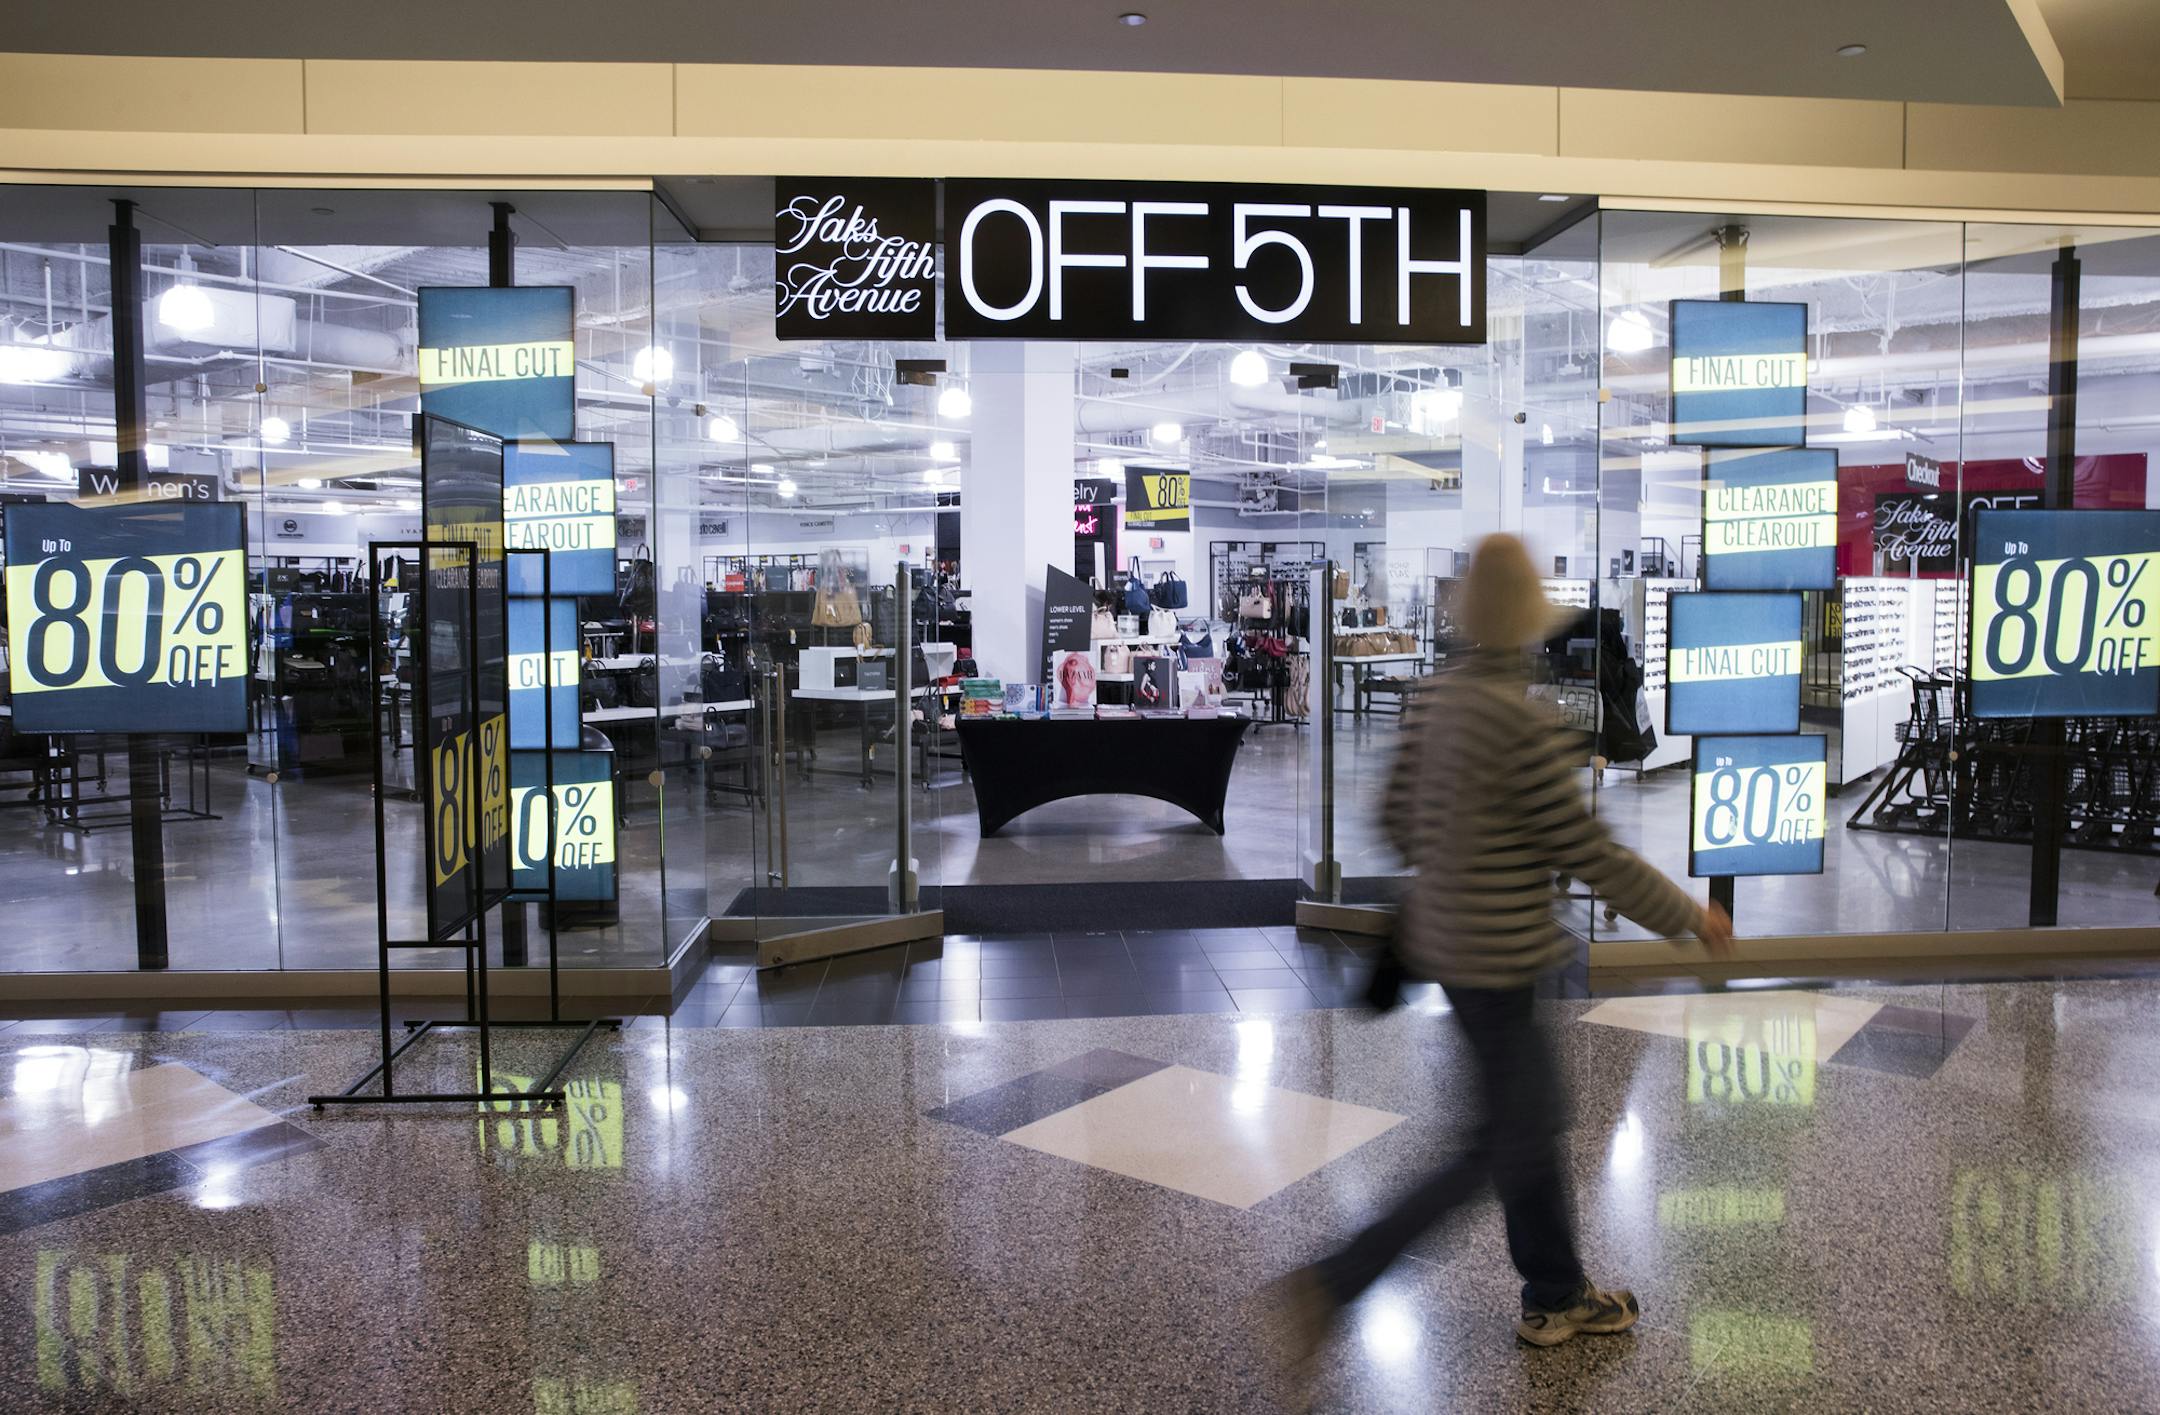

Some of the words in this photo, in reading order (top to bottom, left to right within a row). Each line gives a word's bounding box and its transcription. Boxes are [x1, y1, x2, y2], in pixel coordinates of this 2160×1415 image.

[776, 195, 878, 254] Saks
[960, 199, 1209, 322] OFF
[1234, 203, 1472, 327] 5TH
[776, 263, 922, 320] Avenue
[438, 347, 507, 378] FINAL
[514, 347, 561, 378] CUT
[1690, 356, 1748, 386] FINAL
[1756, 359, 1796, 388] CUT
[90, 473, 210, 499] Wmen's
[1908, 457, 1940, 488] Checkout
[1074, 483, 1099, 502] elry
[1157, 474, 1188, 508] 80%
[1718, 487, 1827, 514] CLEARANCE
[42, 539, 57, 553] Up
[59, 538, 71, 552] To
[509, 522, 594, 550] EAROUT
[1723, 520, 1820, 548] CLEAROUT
[2004, 541, 2017, 555] Up
[2018, 541, 2028, 554] To
[477, 568, 499, 591] EAROUT
[27, 556, 226, 687] 80%
[1050, 606, 1068, 614] LOWER
[1069, 605, 1086, 613] LEVEL
[1986, 557, 2150, 676] 80%
[166, 644, 234, 688] OFF
[1686, 649, 1744, 676] FINAL
[1751, 647, 1791, 676] CUT
[2095, 637, 2151, 676] OFF
[1704, 766, 1813, 846] 80%
[512, 786, 597, 870] 0%
[1780, 818, 1815, 845] OFF
[561, 842, 603, 870] OFF
